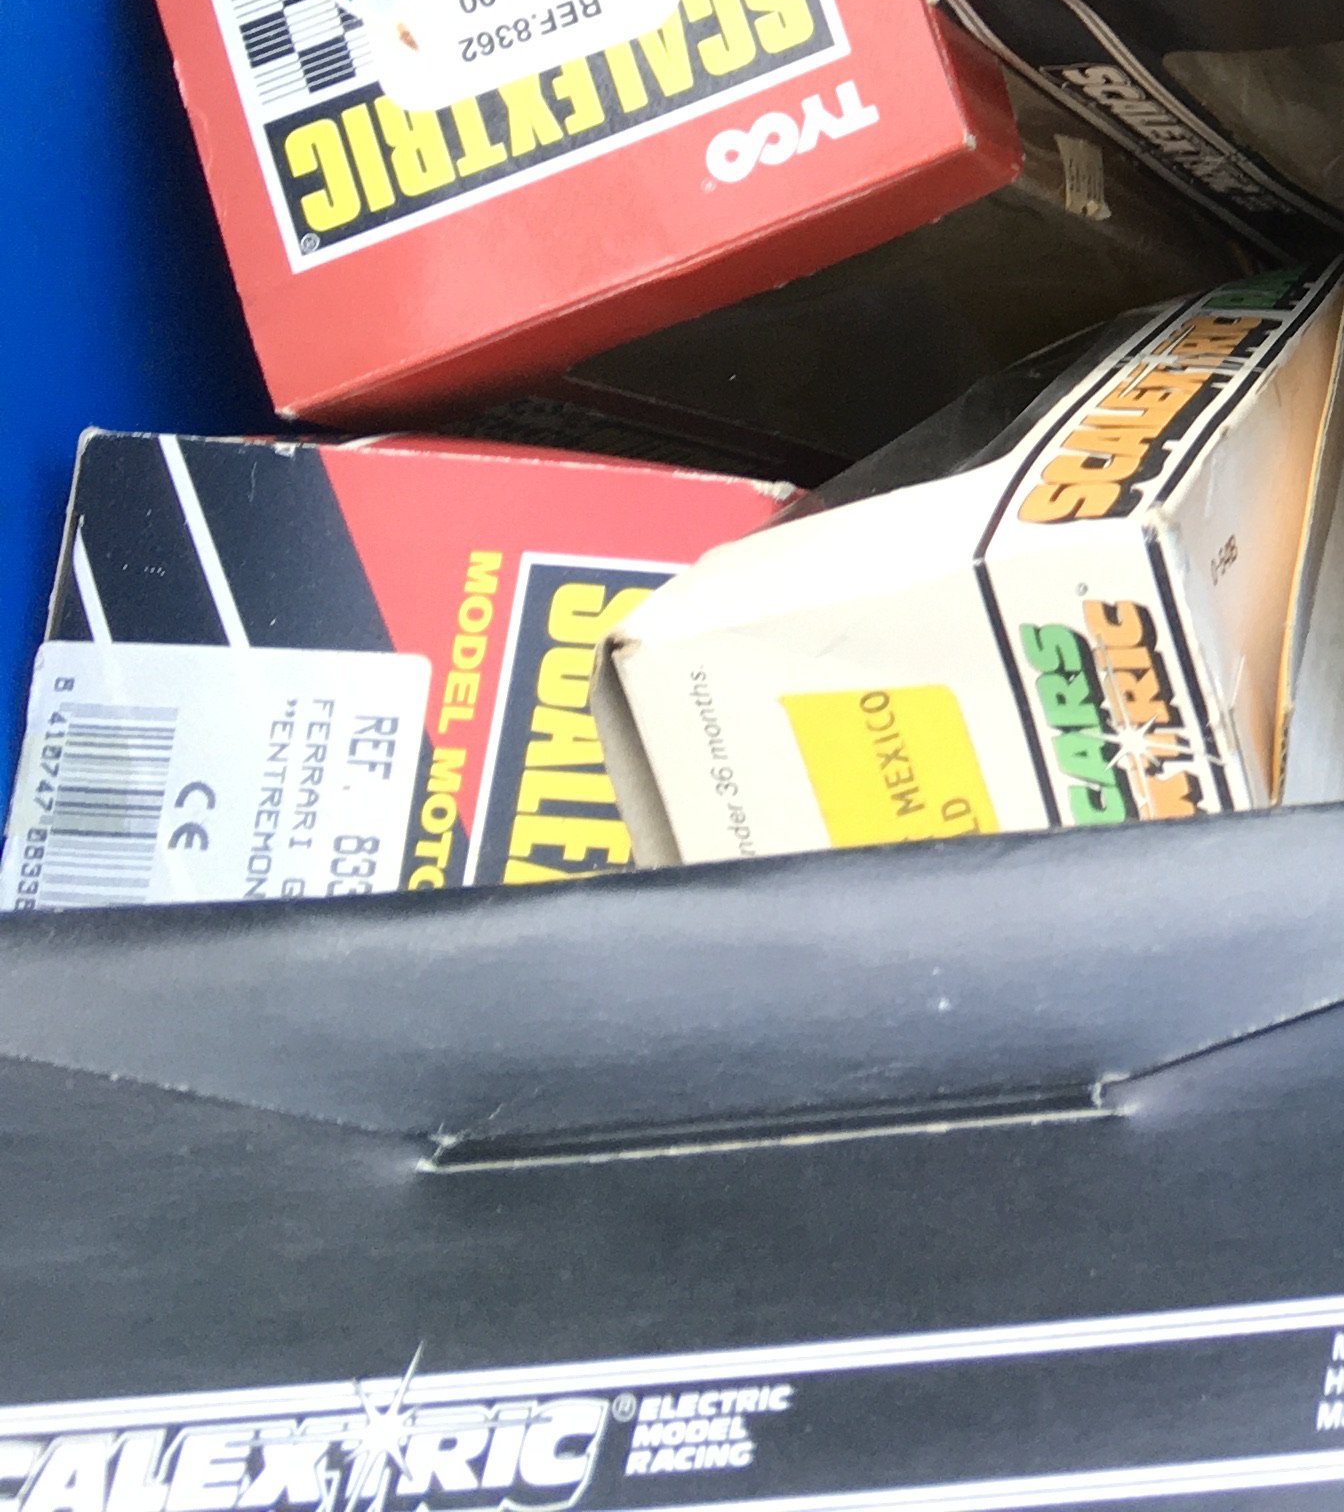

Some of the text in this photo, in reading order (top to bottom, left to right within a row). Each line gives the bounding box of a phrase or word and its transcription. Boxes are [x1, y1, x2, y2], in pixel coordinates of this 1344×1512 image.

[705, 80, 880, 184] TYCO
[437, 551, 502, 734] MODEL
[54, 677, 75, 692] 8
[289, 698, 334, 849] FERRARI
[342, 716, 399, 790] REF.
[859, 690, 925, 817] MEXICO
[710, 766, 739, 796] 36
[637, 1386, 795, 1417] ELECTRIC
[625, 1443, 756, 1476] RACING
[631, 1418, 747, 1448] MODEL
